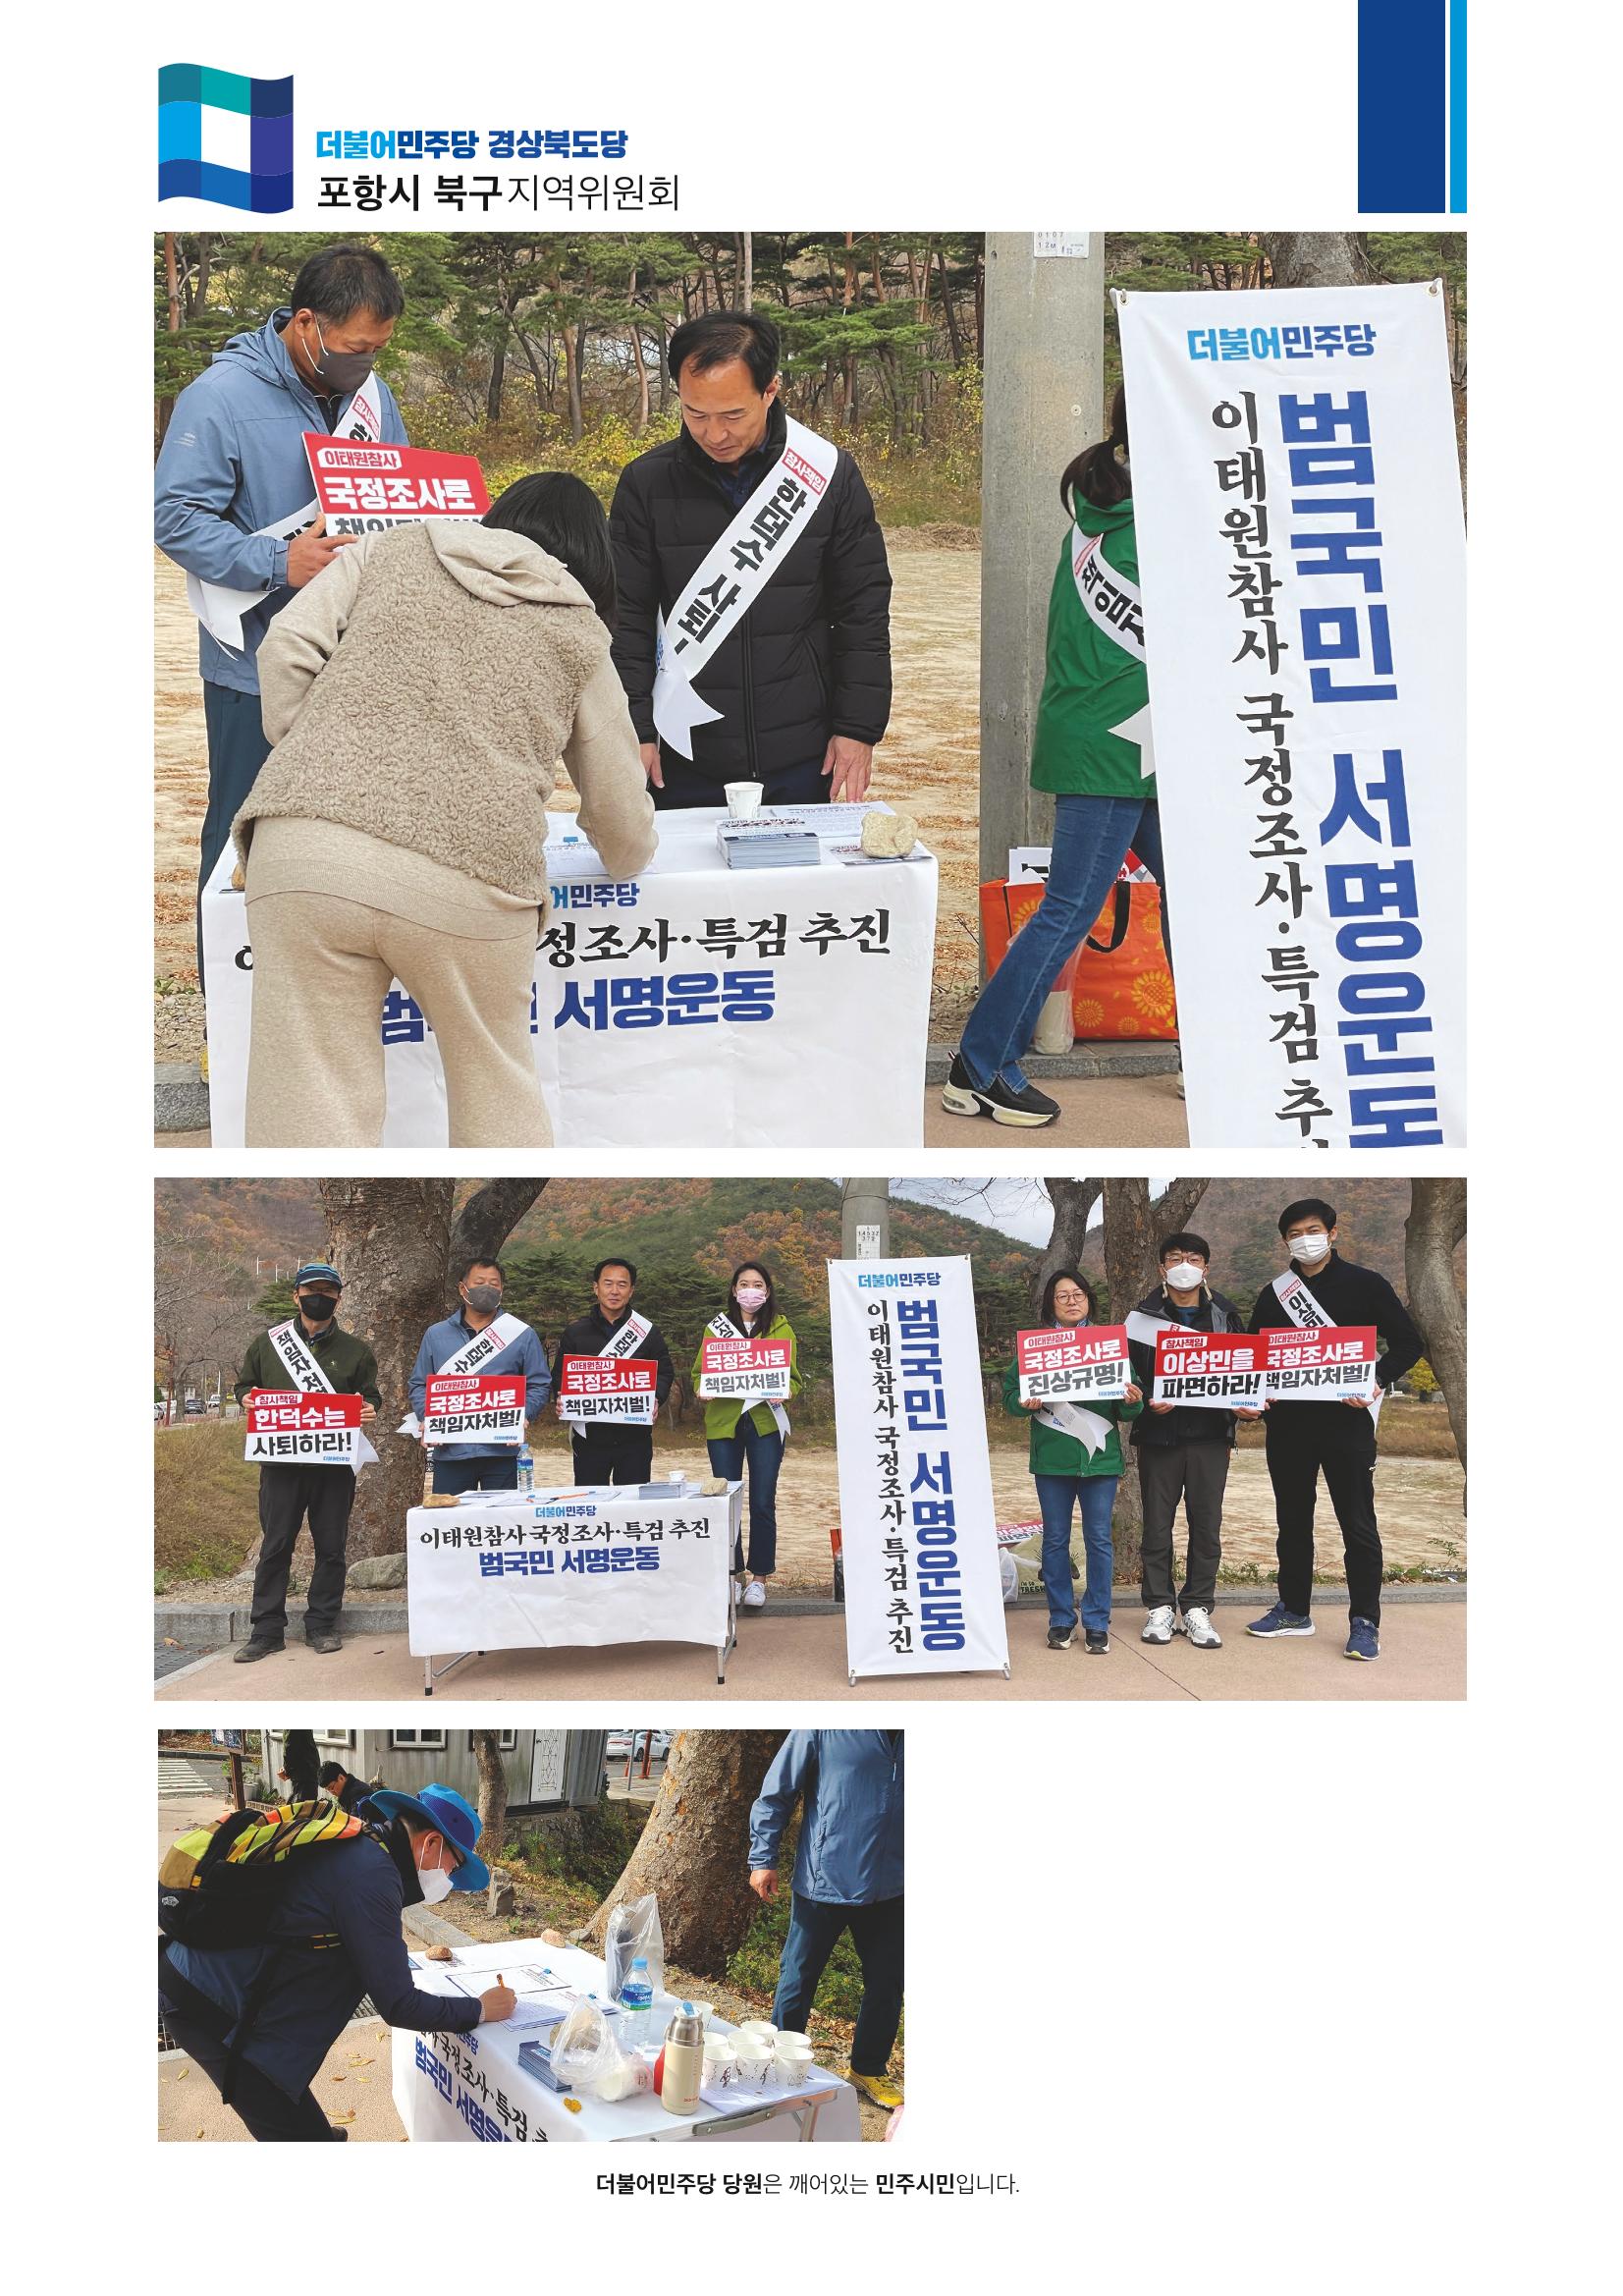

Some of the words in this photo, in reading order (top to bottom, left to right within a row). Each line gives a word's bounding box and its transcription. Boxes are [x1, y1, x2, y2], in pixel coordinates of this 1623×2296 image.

[1186, 324, 1377, 361] 더불어민주당
[324, 450, 398, 467] 이태원참사
[323, 476, 476, 511] 국정조사로
[730, 476, 807, 572] 한덕수
[1278, 390, 1398, 704] 범국민
[1211, 391, 1289, 676] 이태원참사
[1275, 1079, 1334, 1147] 추
[550, 882, 641, 909] 어민주당
[536, 913, 787, 968] 정조사·특검
[799, 908, 893, 958] 추진
[554, 969, 777, 1032] 서명운동
[857, 1272, 942, 1288] 더불어민주당
[276, 1329, 312, 1376] 책임자
[709, 1341, 748, 1351] 이태원참사
[1028, 1333, 1074, 1347] 이태원참사
[1165, 1338, 1204, 1348] 참사책임
[454, 1338, 495, 1374] 한덕수
[570, 1360, 613, 1371] 이태원참사
[706, 1348, 786, 1370] 국정조사로
[896, 1299, 948, 1432] 범국민
[1024, 1339, 1122, 1371] 국정조사로
[1163, 1347, 1255, 1374] 이상민을
[1268, 1340, 1364, 1369] 국정조사로
[434, 1379, 477, 1392] 이태원참사
[567, 1371, 651, 1393] 국정조사로
[705, 1371, 786, 1394] 책임자처벌!
[1027, 1361, 1124, 1397] 진상규명!
[1162, 1373, 1259, 1398] 파면하라!
[429, 1389, 516, 1412] 국정조사로
[565, 1394, 650, 1415] 책임자처벌!
[254, 1406, 346, 1431] 한덕수는
[429, 1408, 521, 1434] 책임자처벌!
[252, 1432, 352, 1456] 사퇴하라!
[867, 1299, 899, 1419] 이태원참사
[886, 1598, 914, 1655] 추진
[535, 1505, 597, 1518] 더불어민주당
[420, 1525, 527, 1550] 이태원참사
[668, 1517, 711, 1540] 추진
[479, 1551, 555, 1577] 범국민
[561, 1546, 661, 1575] 서명운동
[909, 1450, 966, 1652] 서명운동
[415, 2036, 453, 2105] 범국민
